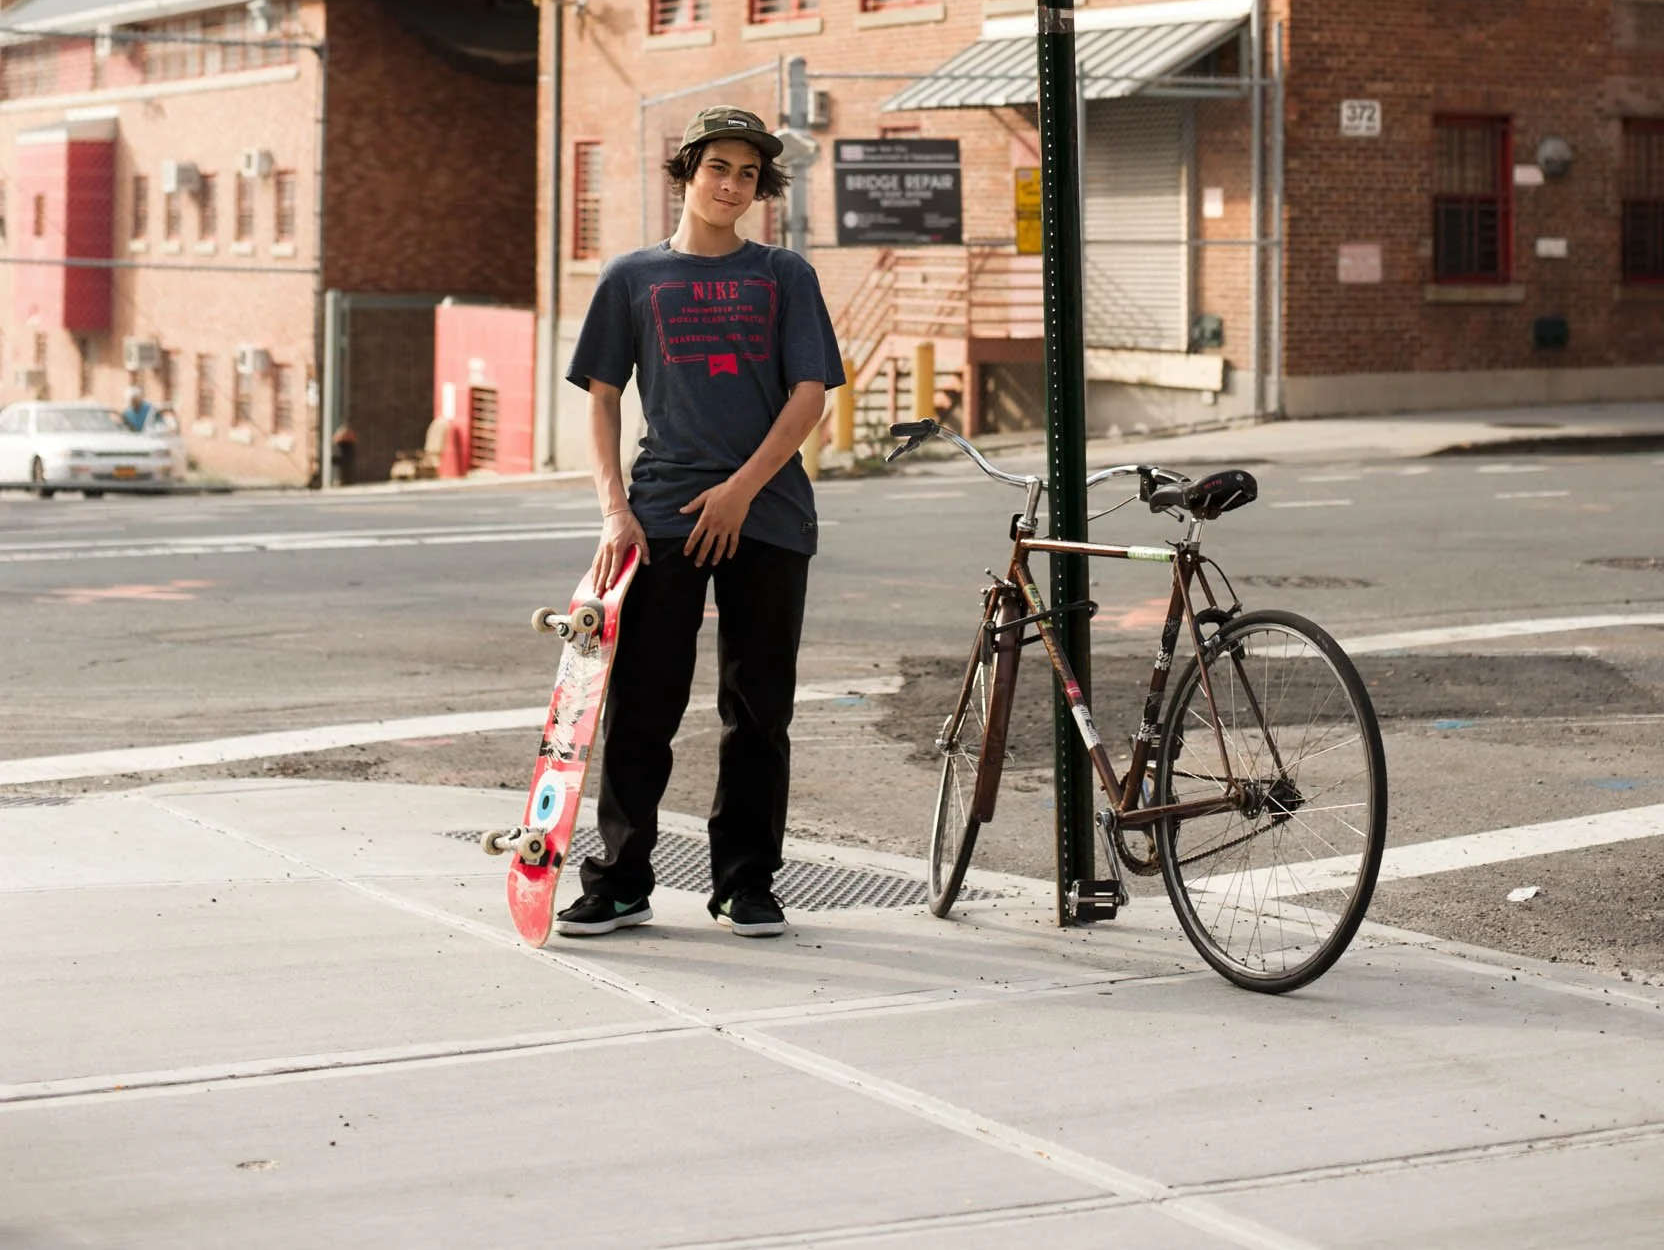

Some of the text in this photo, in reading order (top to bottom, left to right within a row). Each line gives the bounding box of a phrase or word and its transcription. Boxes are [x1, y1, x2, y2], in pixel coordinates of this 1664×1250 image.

[1347, 103, 1376, 122] 372
[846, 174, 953, 190] BRIDGE REPAIR
[692, 281, 740, 300] NIKE
